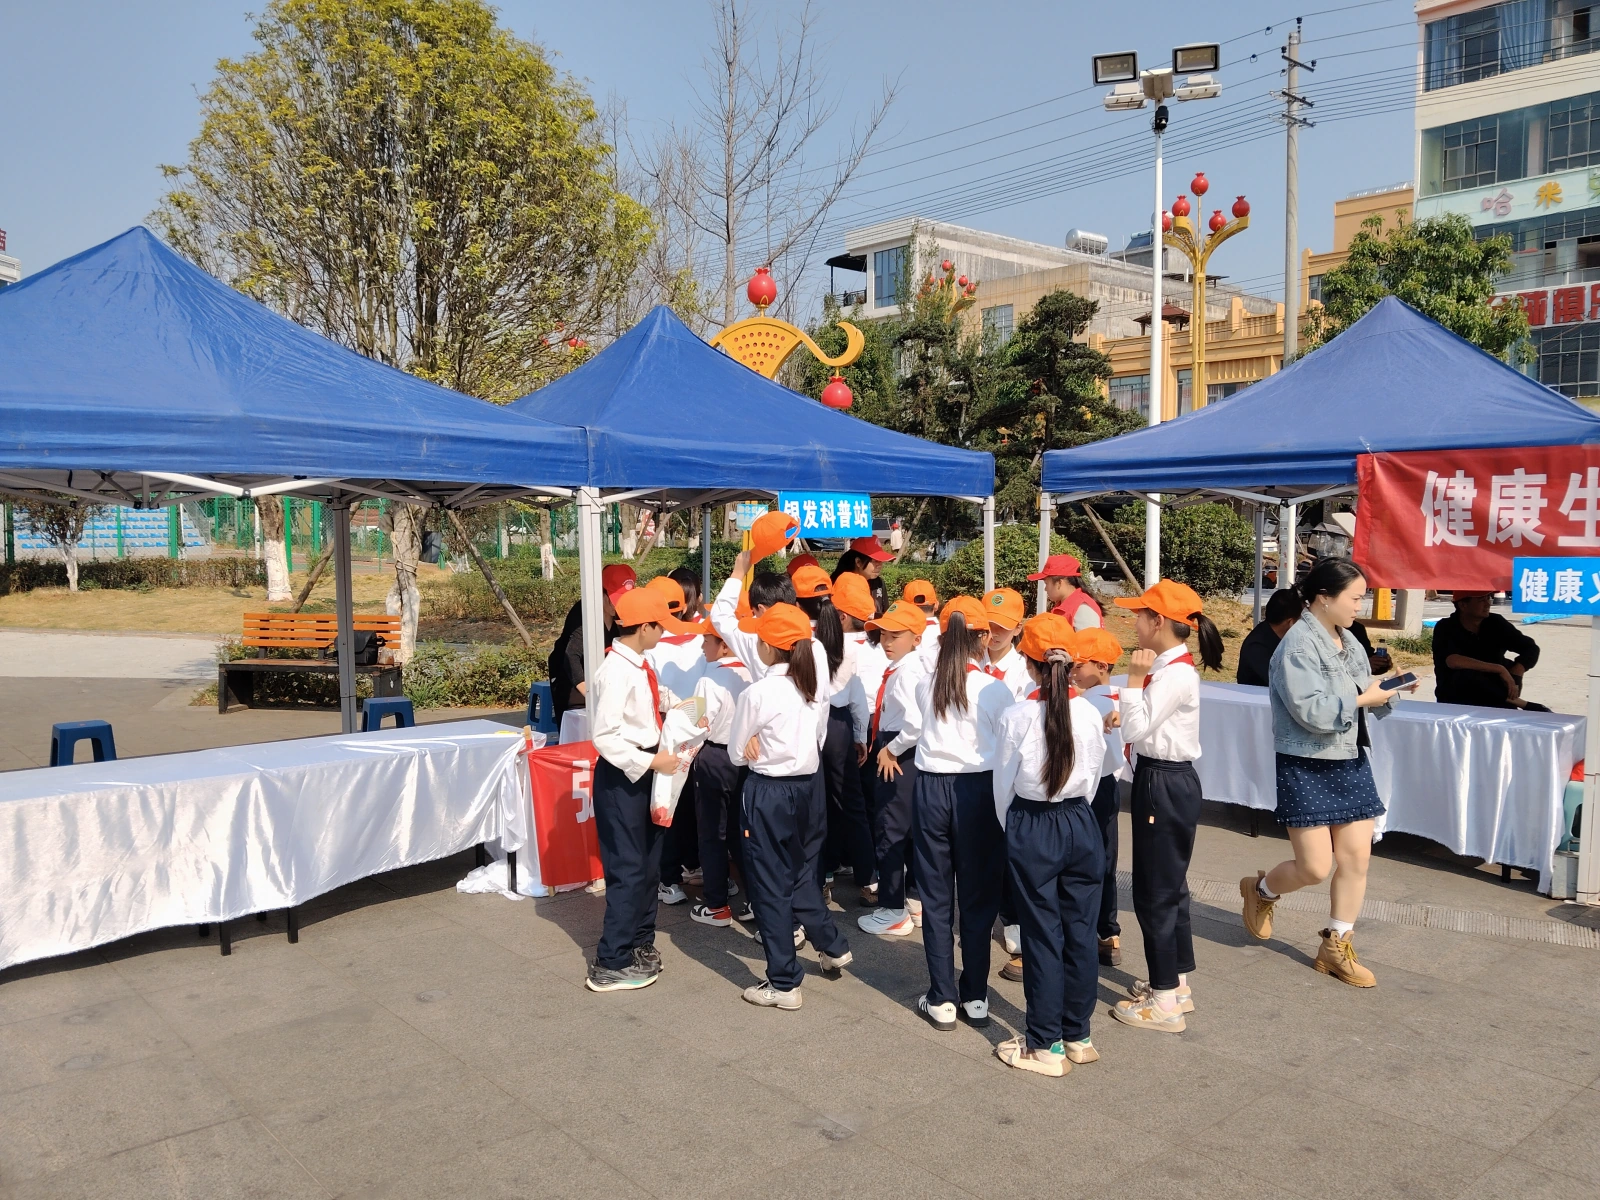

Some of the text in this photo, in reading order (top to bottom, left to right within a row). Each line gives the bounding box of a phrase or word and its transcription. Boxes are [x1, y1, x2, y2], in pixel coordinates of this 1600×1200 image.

[783, 499, 869, 529] 银发科普站
[1420, 466, 1600, 548] 健康生
